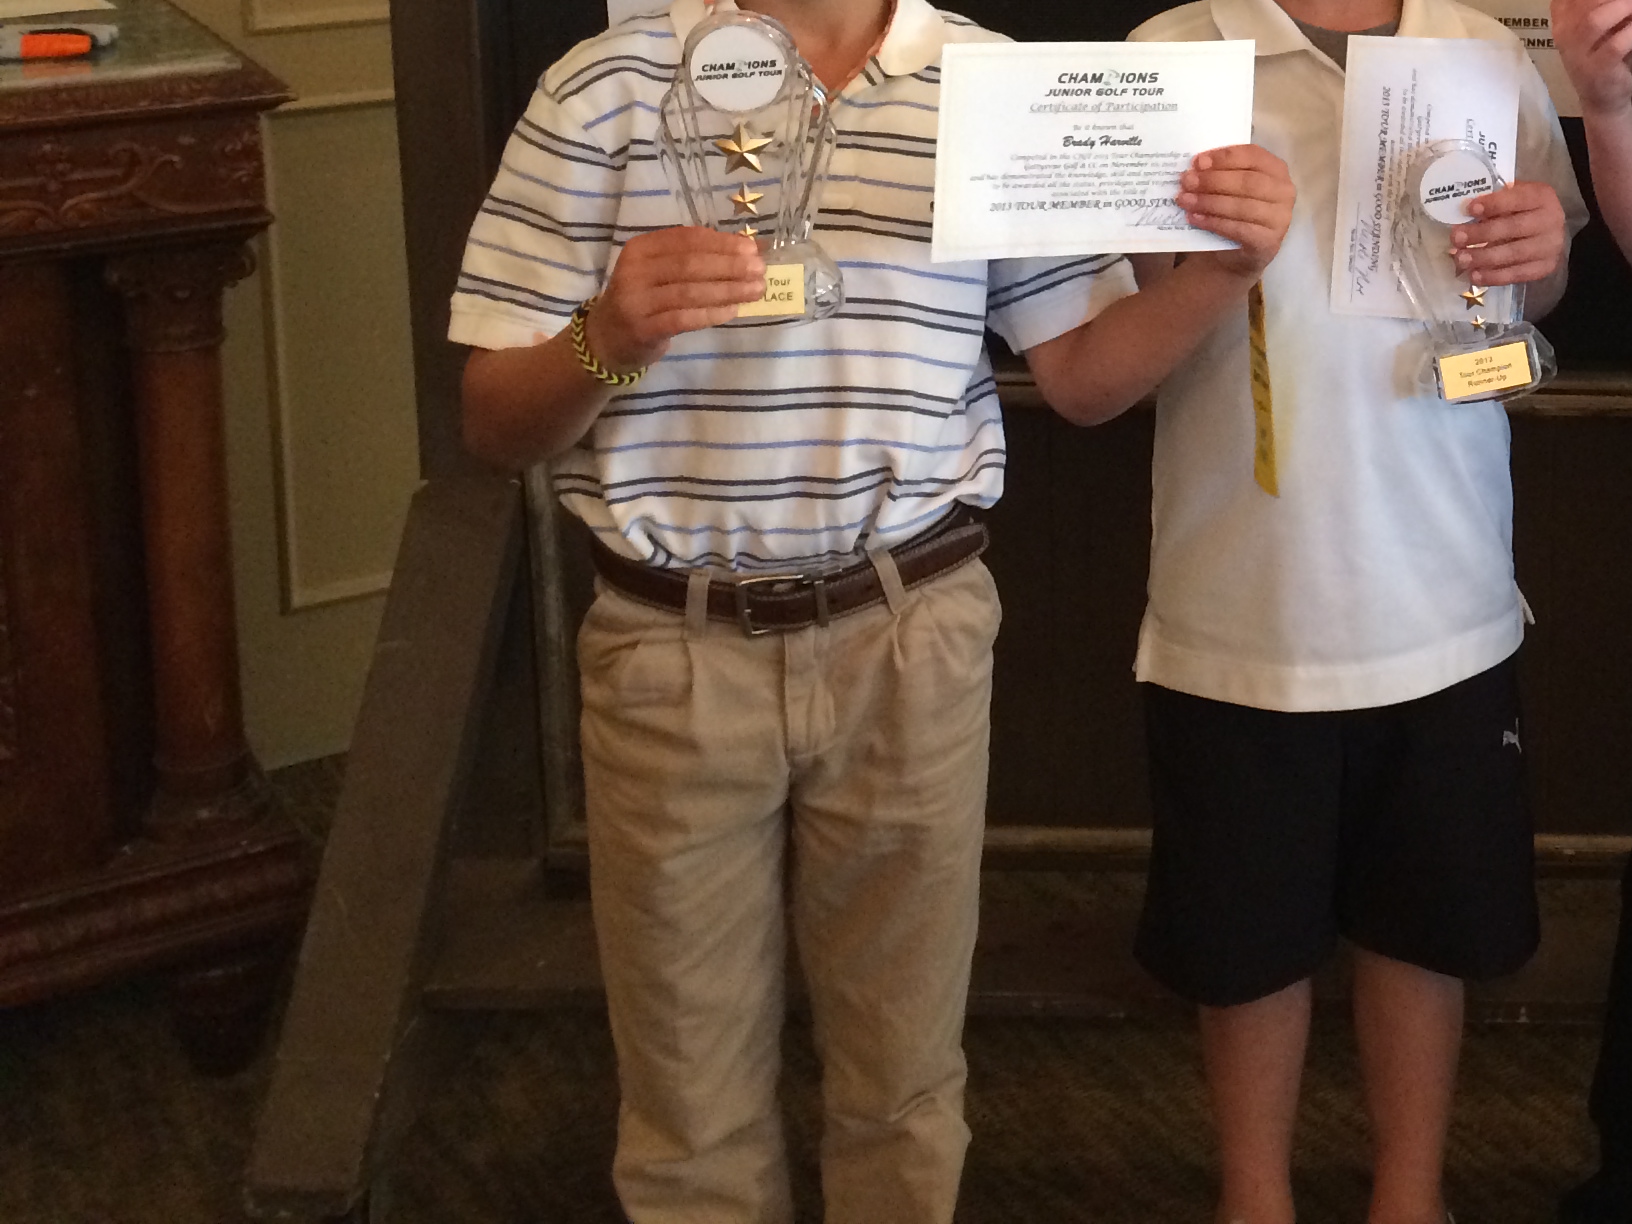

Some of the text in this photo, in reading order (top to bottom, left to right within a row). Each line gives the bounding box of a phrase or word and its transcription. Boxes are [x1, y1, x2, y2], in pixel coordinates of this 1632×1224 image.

[1058, 69, 1159, 85] CHAMPIONS
[1045, 88, 1164, 96] JUNIOR GOLF TOUR
[768, 277, 790, 286] Tour
